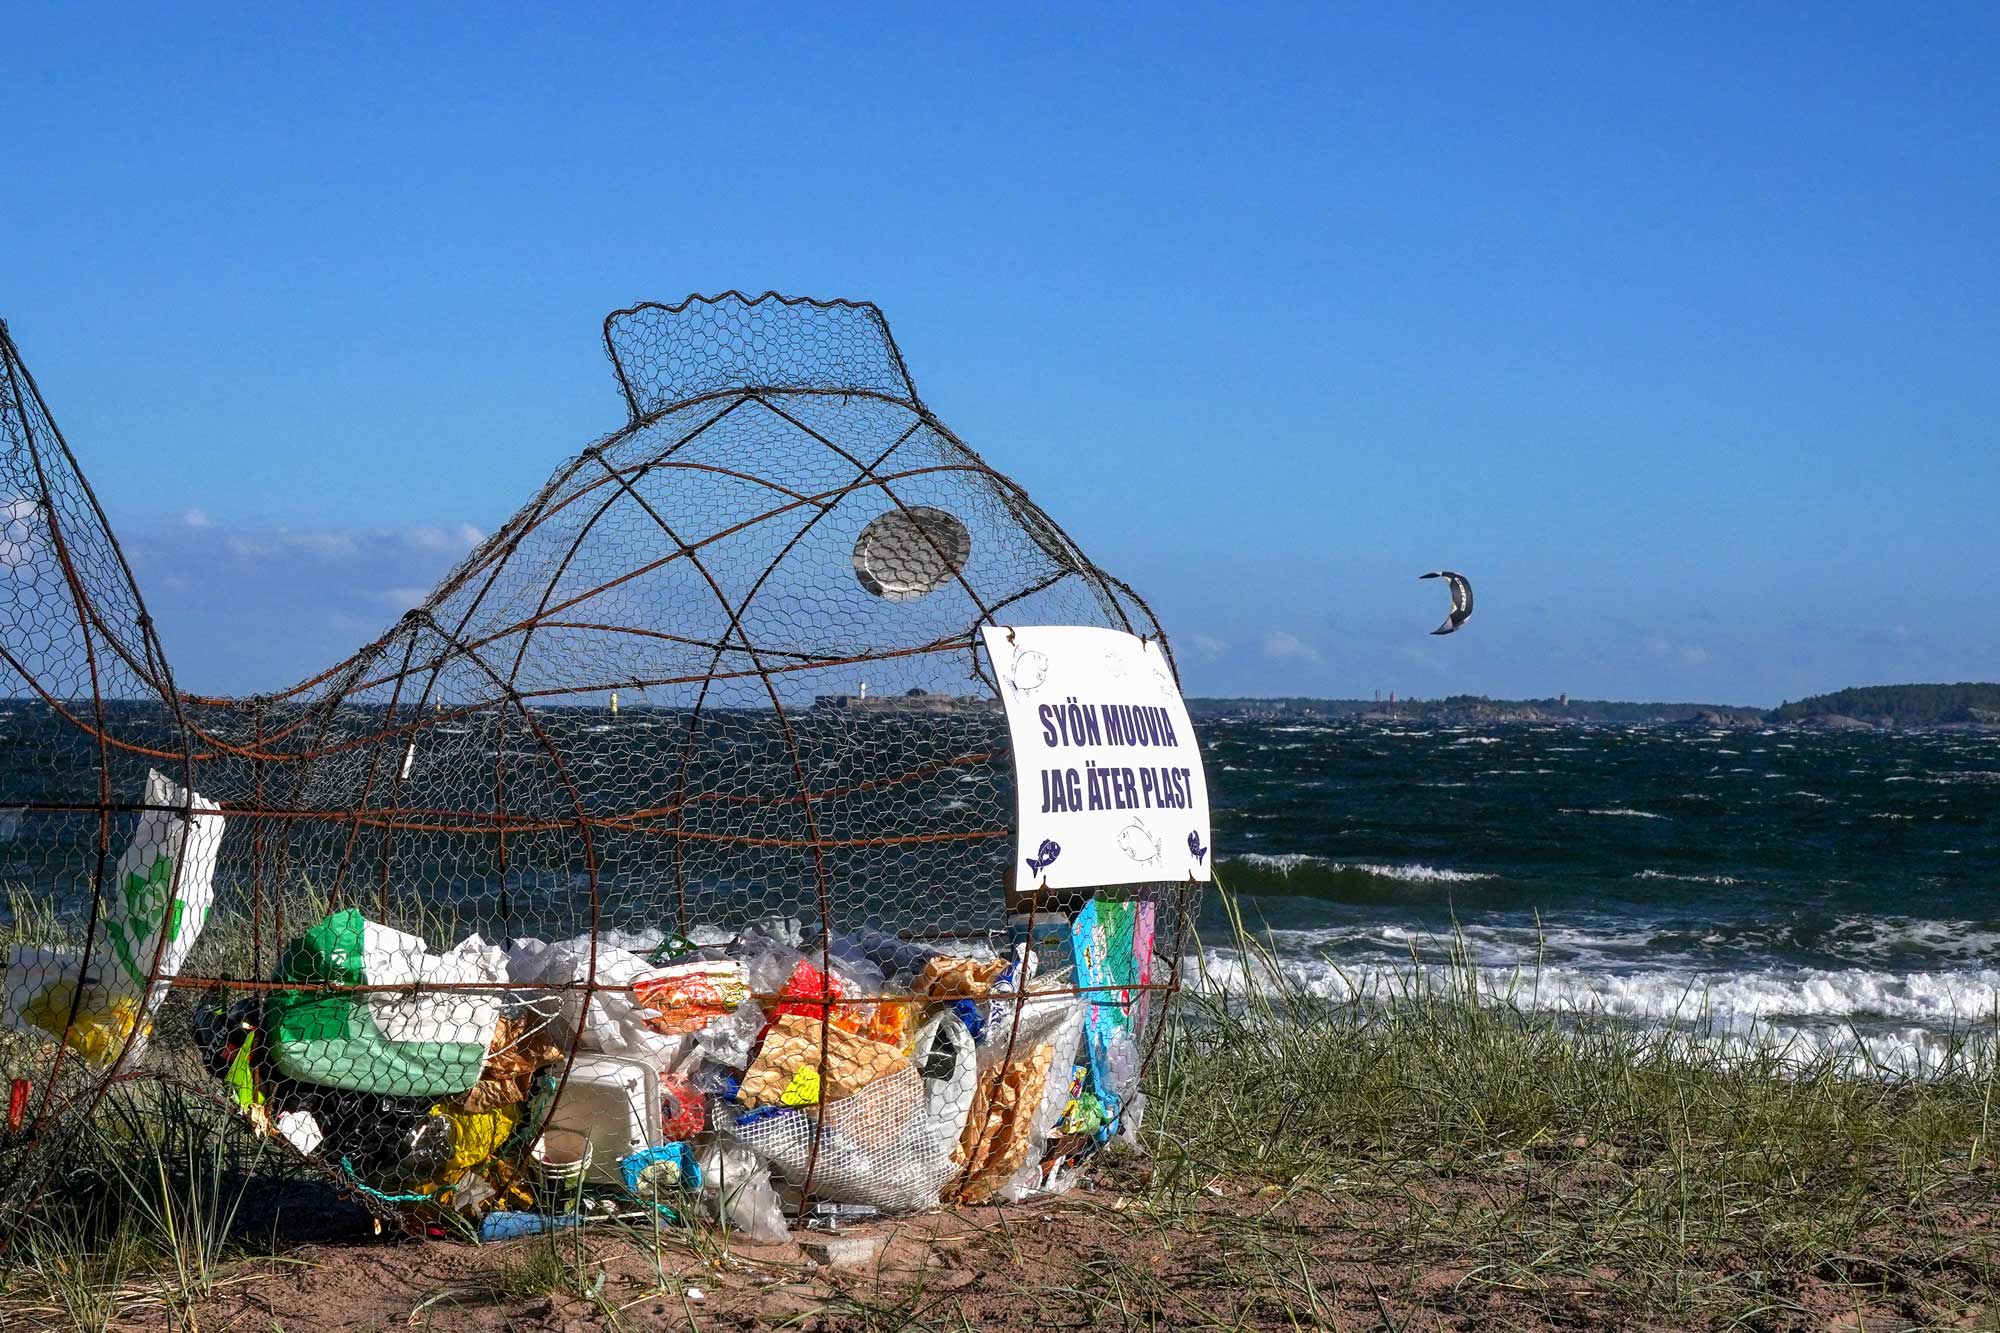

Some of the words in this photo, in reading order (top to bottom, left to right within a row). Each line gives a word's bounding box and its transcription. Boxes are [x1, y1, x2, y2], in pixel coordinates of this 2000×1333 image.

[1039, 697, 1101, 748] SYÖN
[1102, 704, 1178, 748] MUOVIA
[1041, 768, 1083, 813] JAG
[1086, 760, 1140, 811] ÄTER
[1139, 767, 1193, 810] PLAST
